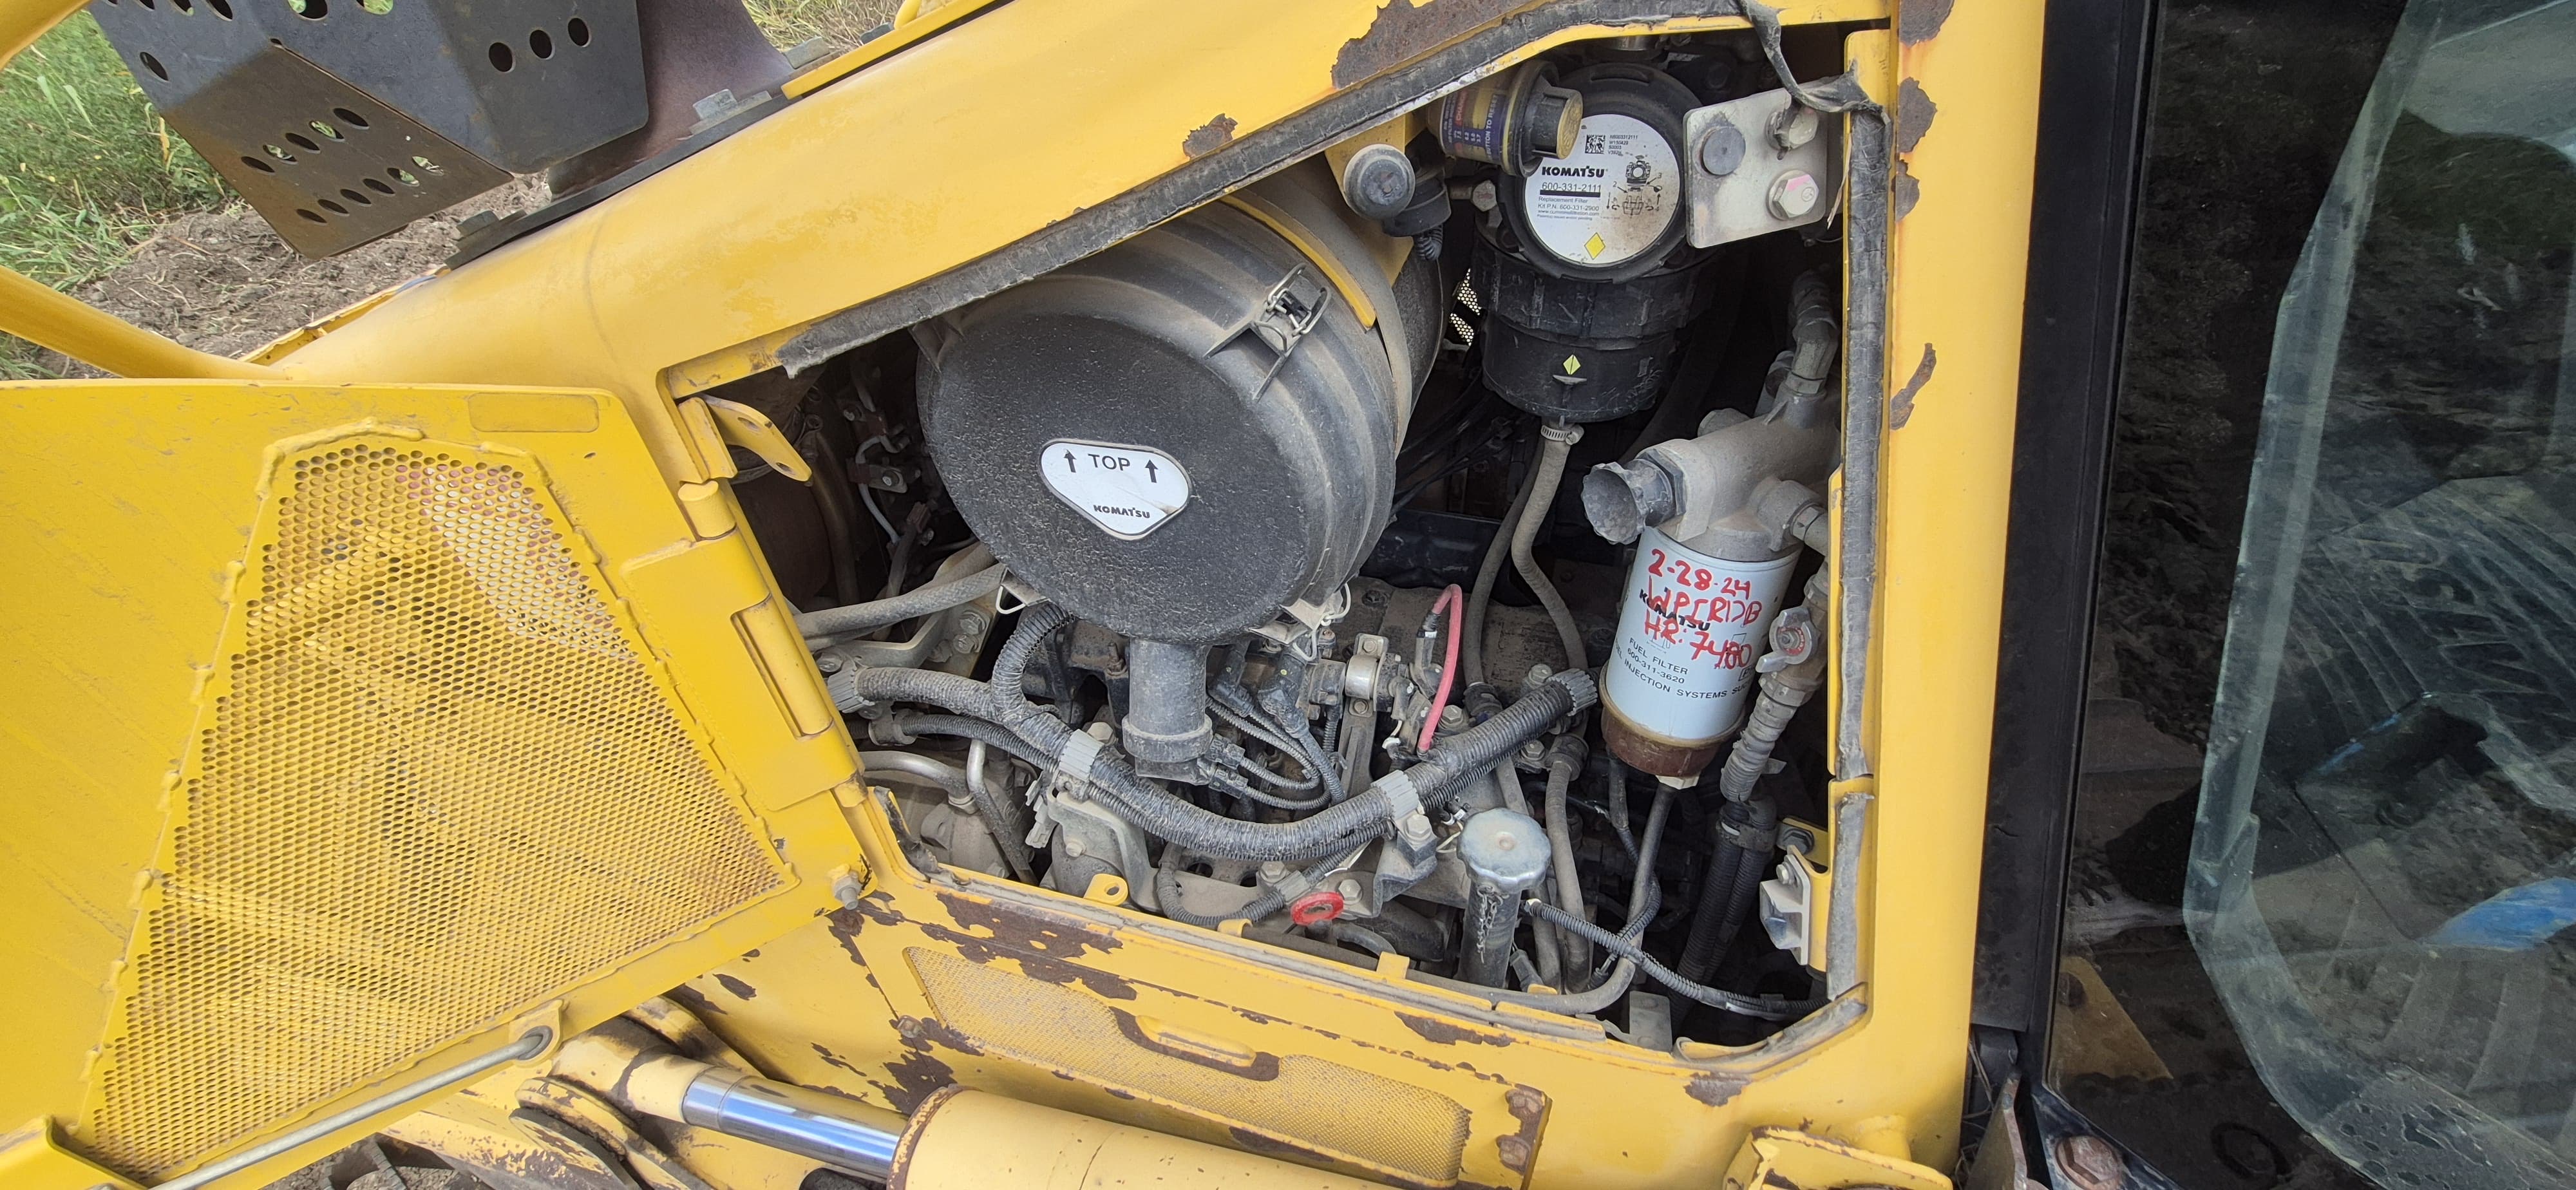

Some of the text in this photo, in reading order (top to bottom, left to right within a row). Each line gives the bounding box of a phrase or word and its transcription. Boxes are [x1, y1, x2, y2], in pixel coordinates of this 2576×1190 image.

[1486, 120, 1492, 129] TO
[1542, 165, 1604, 178] KOMATSU
[1542, 182, 1602, 193] 600-331-2111
[1088, 453, 1131, 471] TOP
[1093, 505, 1150, 518] KOMATSU
[1648, 548, 1751, 600] 2-28-24
[1629, 637, 1688, 675] FUEL FILTER
[1627, 648, 1685, 684] 600-311-3620
[1624, 659, 1671, 692] INJECTION
[1676, 689, 1728, 699] SYSTEMS
